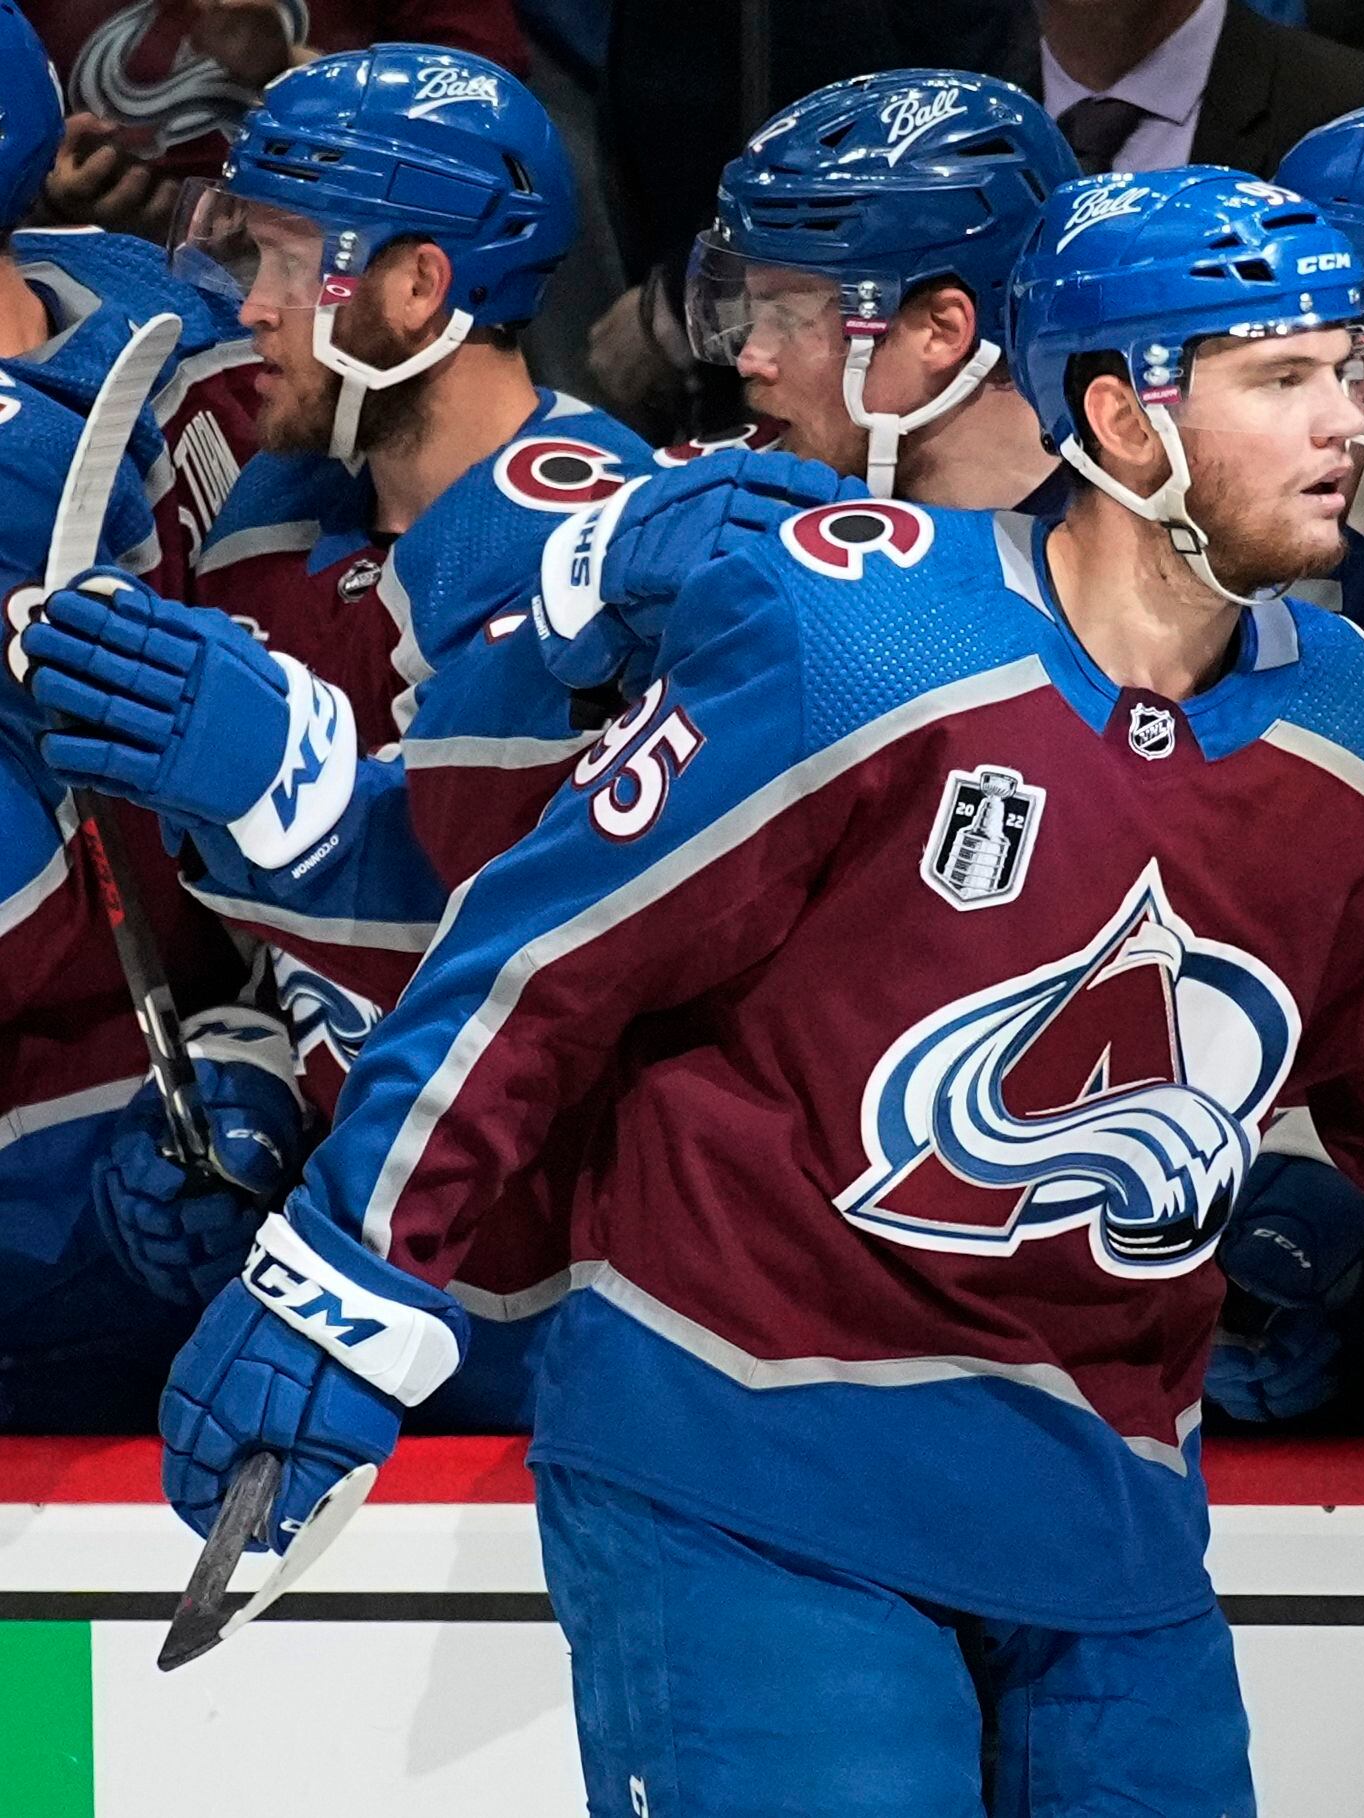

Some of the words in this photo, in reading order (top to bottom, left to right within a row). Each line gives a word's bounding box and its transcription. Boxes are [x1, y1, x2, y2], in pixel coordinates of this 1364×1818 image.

[408, 67, 498, 116] Ball
[881, 88, 967, 165] Ball
[1057, 185, 1150, 250] Ball
[1297, 252, 1351, 275] CCM
[574, 678, 708, 845] 95
[955, 801, 975, 817] 20
[1005, 813, 1025, 829] 22
[291, 834, 340, 879] O'CONNOR
[246, 1243, 388, 1348] CM
